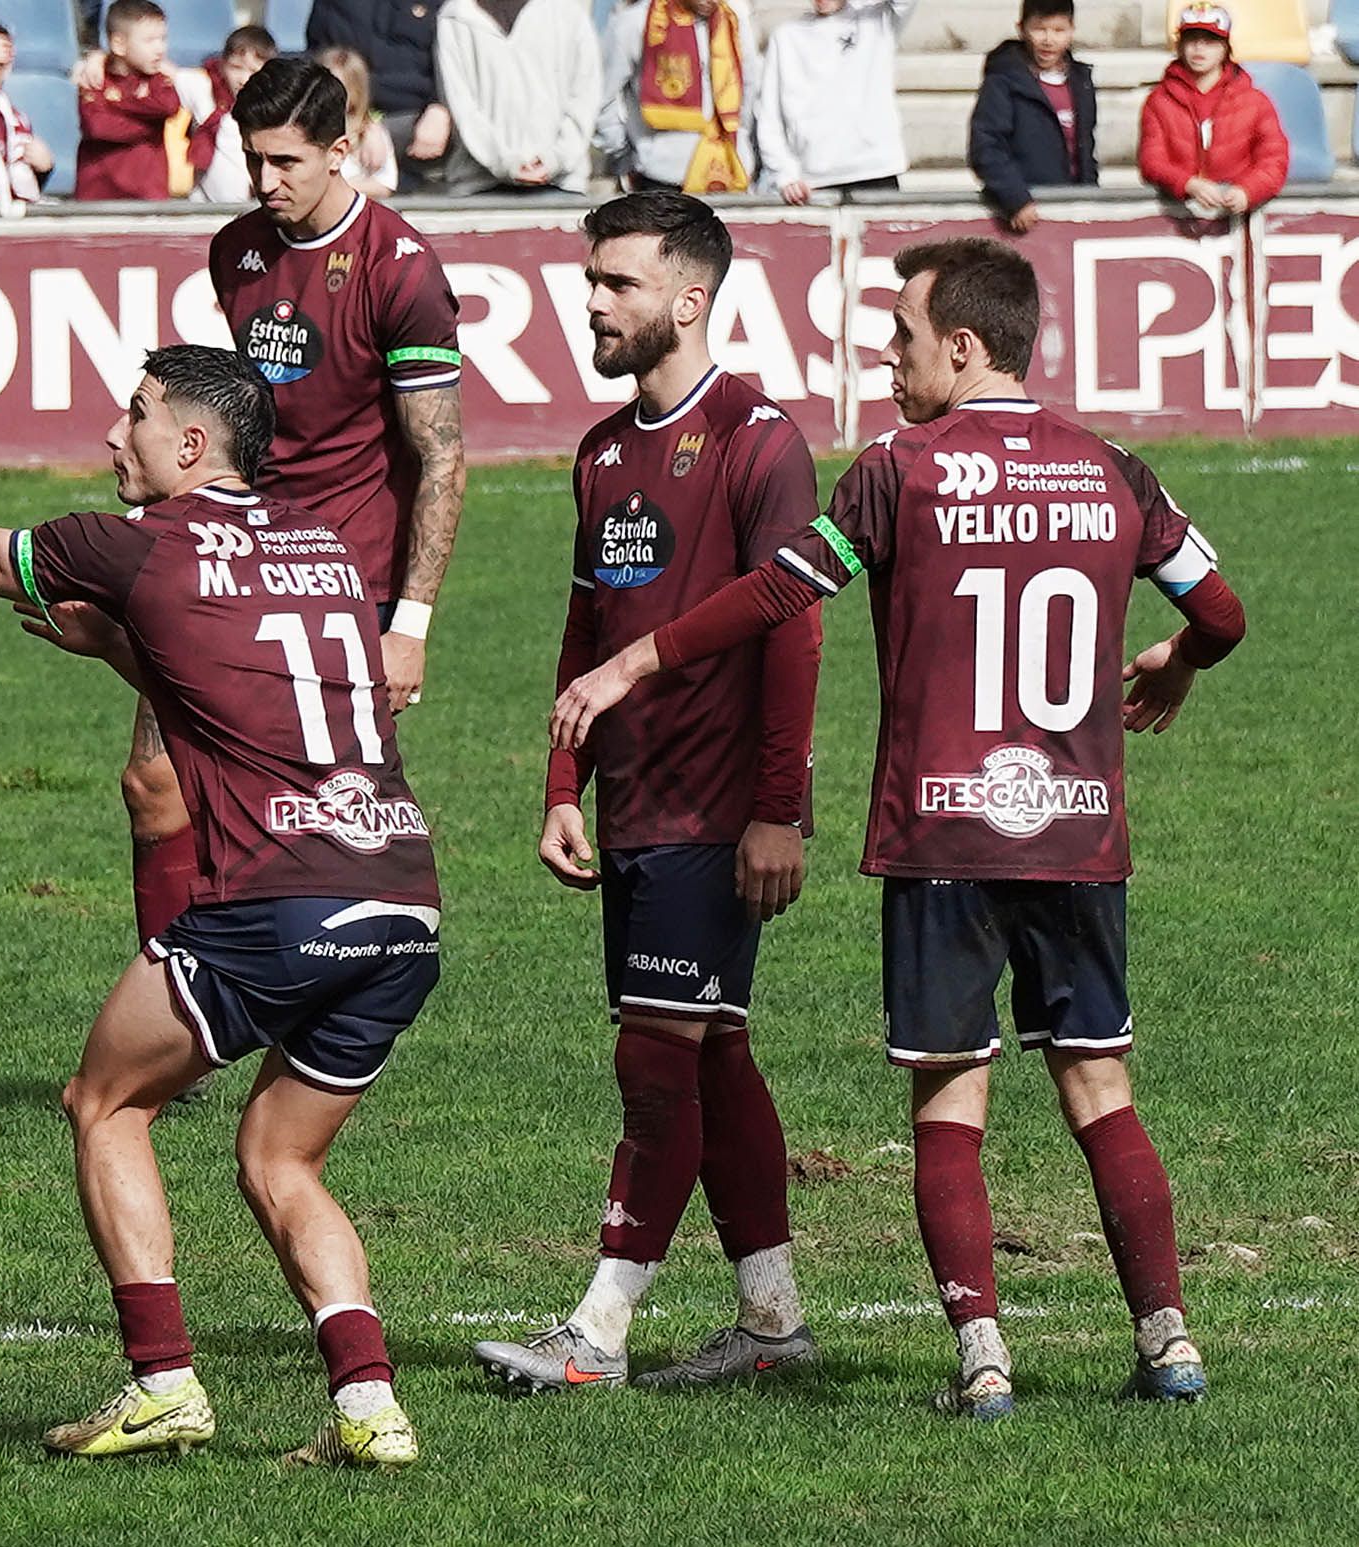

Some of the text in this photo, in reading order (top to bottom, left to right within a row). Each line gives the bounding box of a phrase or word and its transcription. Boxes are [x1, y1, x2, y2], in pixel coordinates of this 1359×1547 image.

[1074, 234, 1359, 413] PE
[1004, 459, 1105, 479] Deputación
[1006, 476, 1107, 493] Pontevedra
[255, 526, 338, 545] Deputación
[933, 502, 1117, 545] YELKO PINO
[261, 541, 348, 556] Pontevedra
[198, 560, 365, 602] M. CUESTA
[953, 567, 1099, 733] 10
[254, 612, 386, 765] 11
[921, 777, 1109, 815] PESCAMAR
[627, 953, 700, 978] ABANCA
